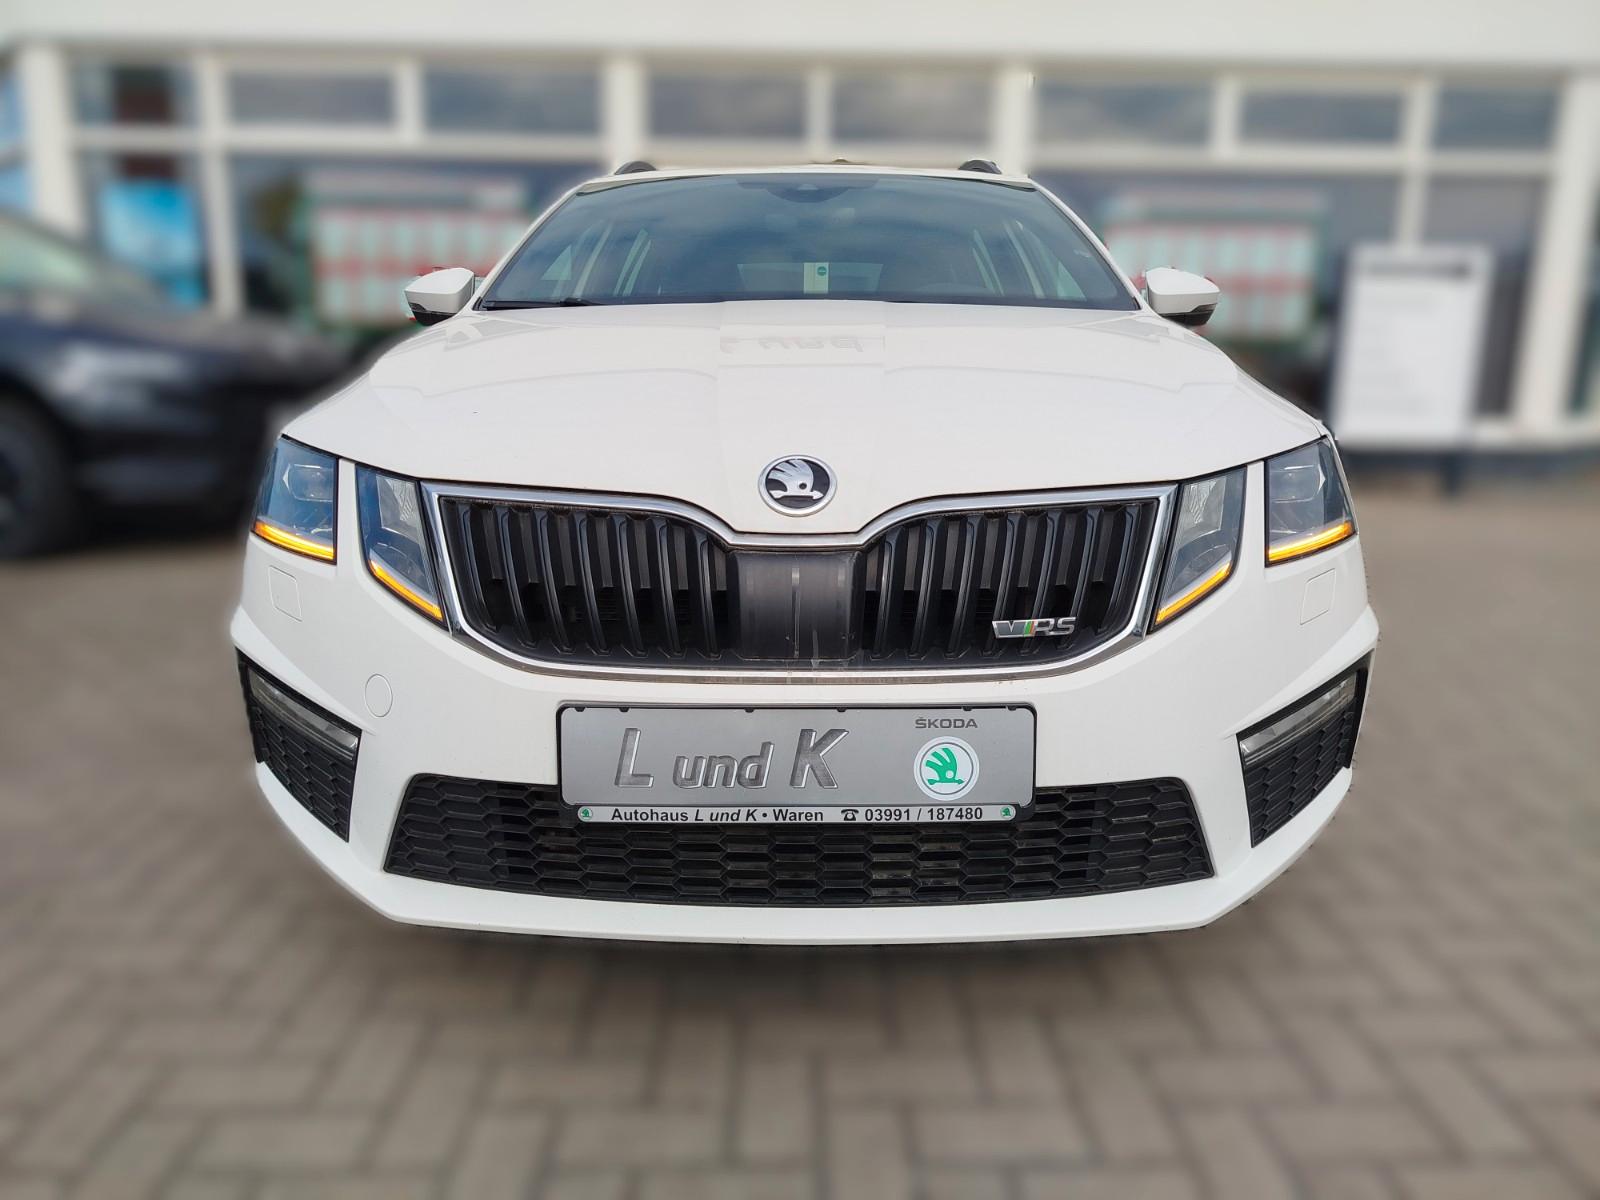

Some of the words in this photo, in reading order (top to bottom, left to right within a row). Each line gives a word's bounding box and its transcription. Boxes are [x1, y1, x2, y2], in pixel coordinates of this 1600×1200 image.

[914, 717, 979, 729] ŠKODA
[614, 728, 655, 788] L
[672, 741, 775, 789] und
[789, 728, 850, 789] K
[611, 808, 689, 822] Autohaus
[694, 809, 705, 822] L
[709, 809, 741, 822] und
[745, 809, 759, 822] K
[773, 808, 824, 822] Waren
[864, 808, 911, 822] 03991
[927, 807, 984, 821] 187480
